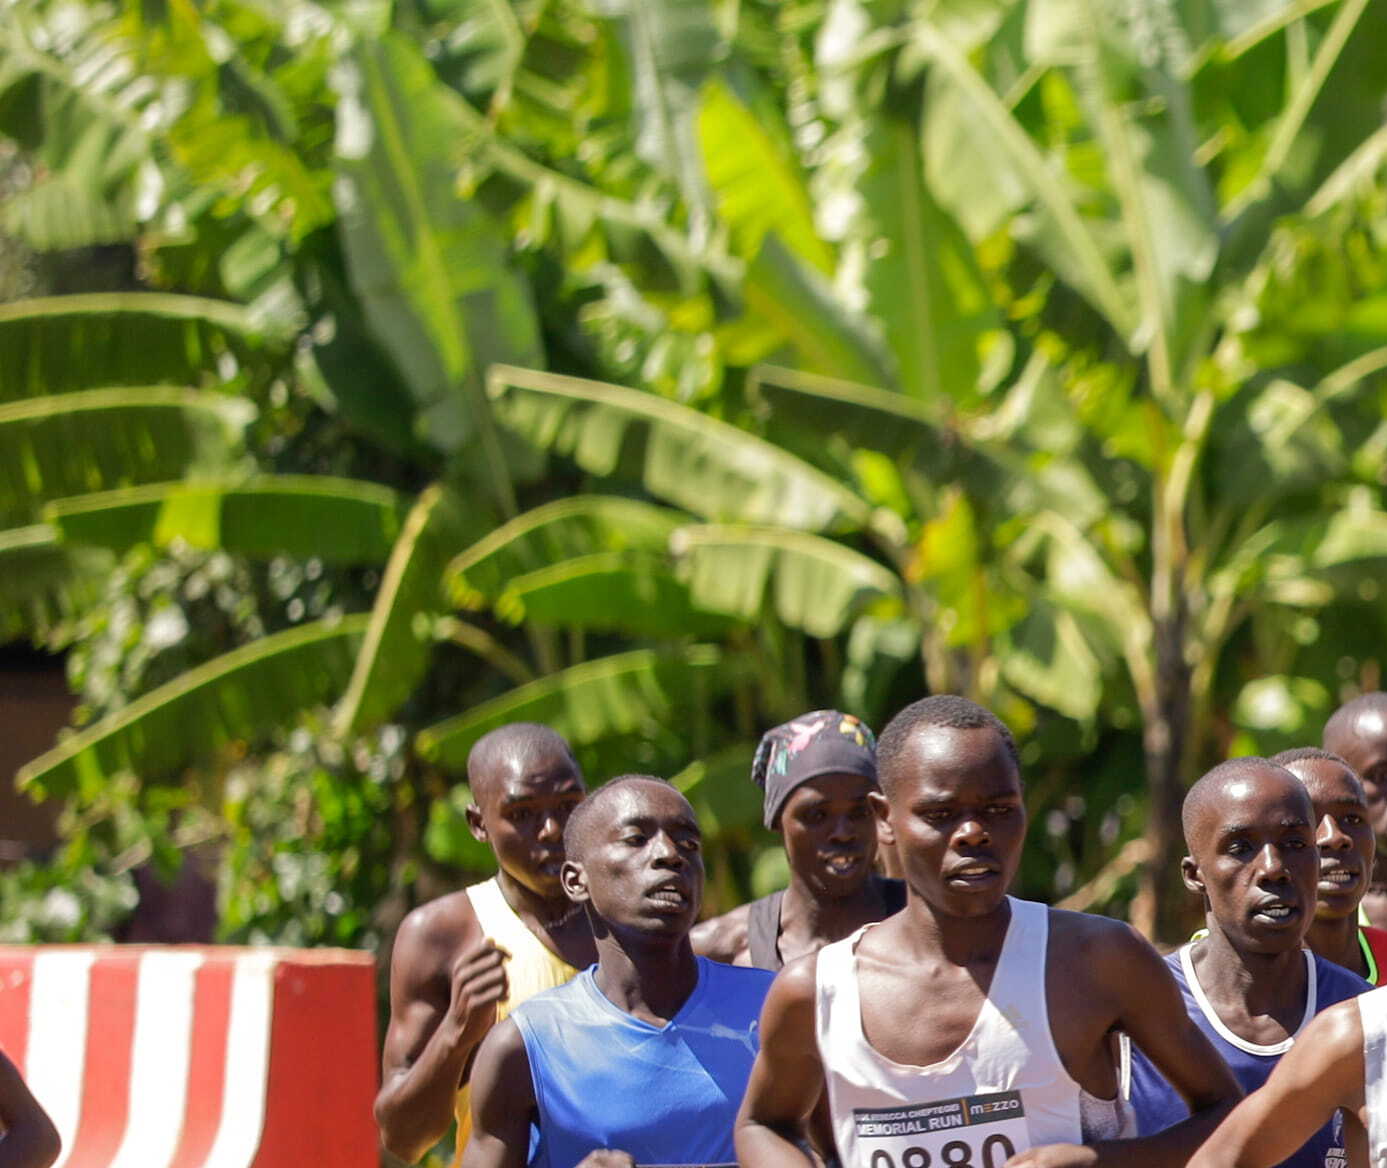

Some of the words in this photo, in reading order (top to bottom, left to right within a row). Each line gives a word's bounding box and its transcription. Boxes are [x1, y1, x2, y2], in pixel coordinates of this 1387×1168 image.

[970, 1099, 1019, 1115] mezzo
[856, 1121, 927, 1136] MEMORIAL
[929, 1114, 963, 1131] RUN
